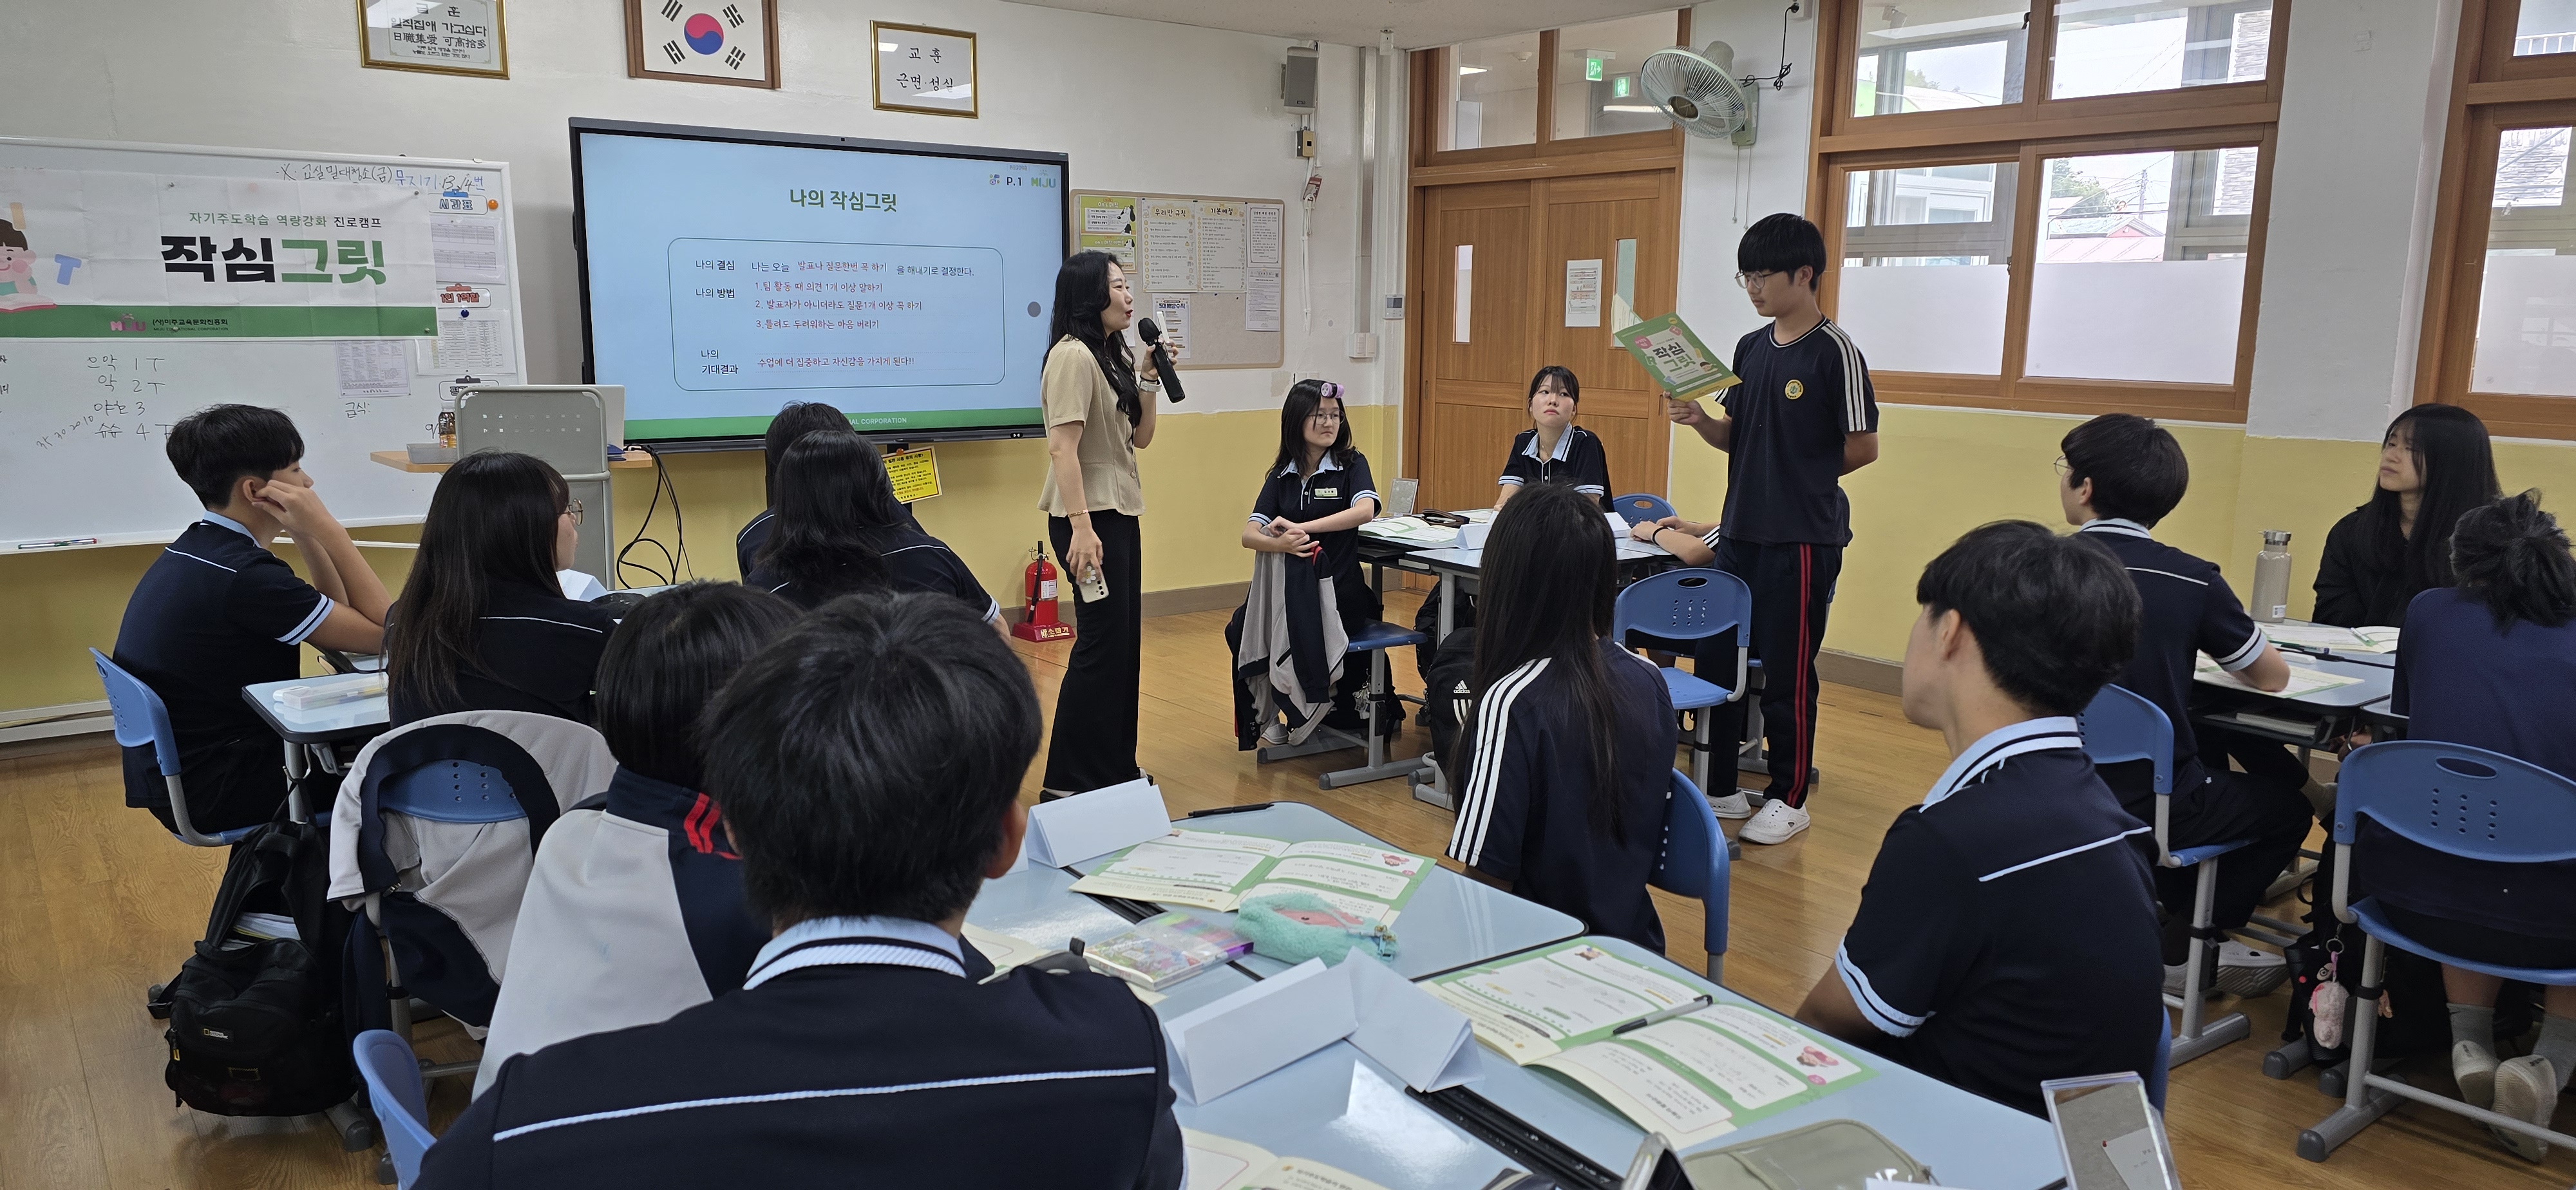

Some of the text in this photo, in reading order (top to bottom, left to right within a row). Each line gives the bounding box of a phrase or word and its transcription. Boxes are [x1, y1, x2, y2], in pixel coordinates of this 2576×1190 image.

[1031, 176, 1056, 188] MIJU
[439, 199, 473, 211] 시간표
[790, 189, 897, 212] 나의 작심그릿
[189, 212, 383, 228] 자기주도학습 역량강화 진로캠프
[160, 236, 387, 285] 작심그릿
[696, 260, 735, 270] 나의 결심
[752, 261, 974, 276] 나는 오늘 발표나 질문한번 꼭 하기 을 해내기로 결정한다.
[773, 281, 791, 292] 활동
[795, 282, 803, 291] 때
[806, 282, 822, 292] 의견
[826, 283, 838, 292] 1개
[841, 283, 857, 292] 이상
[859, 283, 883, 293] 말하기
[696, 288, 735, 298] 나의 방법
[766, 299, 800, 310] 발표자가
[804, 300, 844, 310] 아니더라도
[847, 300, 876, 310] 질문1개
[878, 301, 894, 310] 이상
[896, 301, 905, 310] 꼭
[907, 301, 922, 310] 하기
[793, 319, 835, 329] 두려워하는
[837, 319, 854, 330] 마음
[857, 320, 880, 329] 버리기
[701, 350, 719, 359] 나의
[757, 357, 914, 367] 수업에 더 집중하고 자신감을 가지게 된다!!
[701, 364, 739, 375] 기대결과
